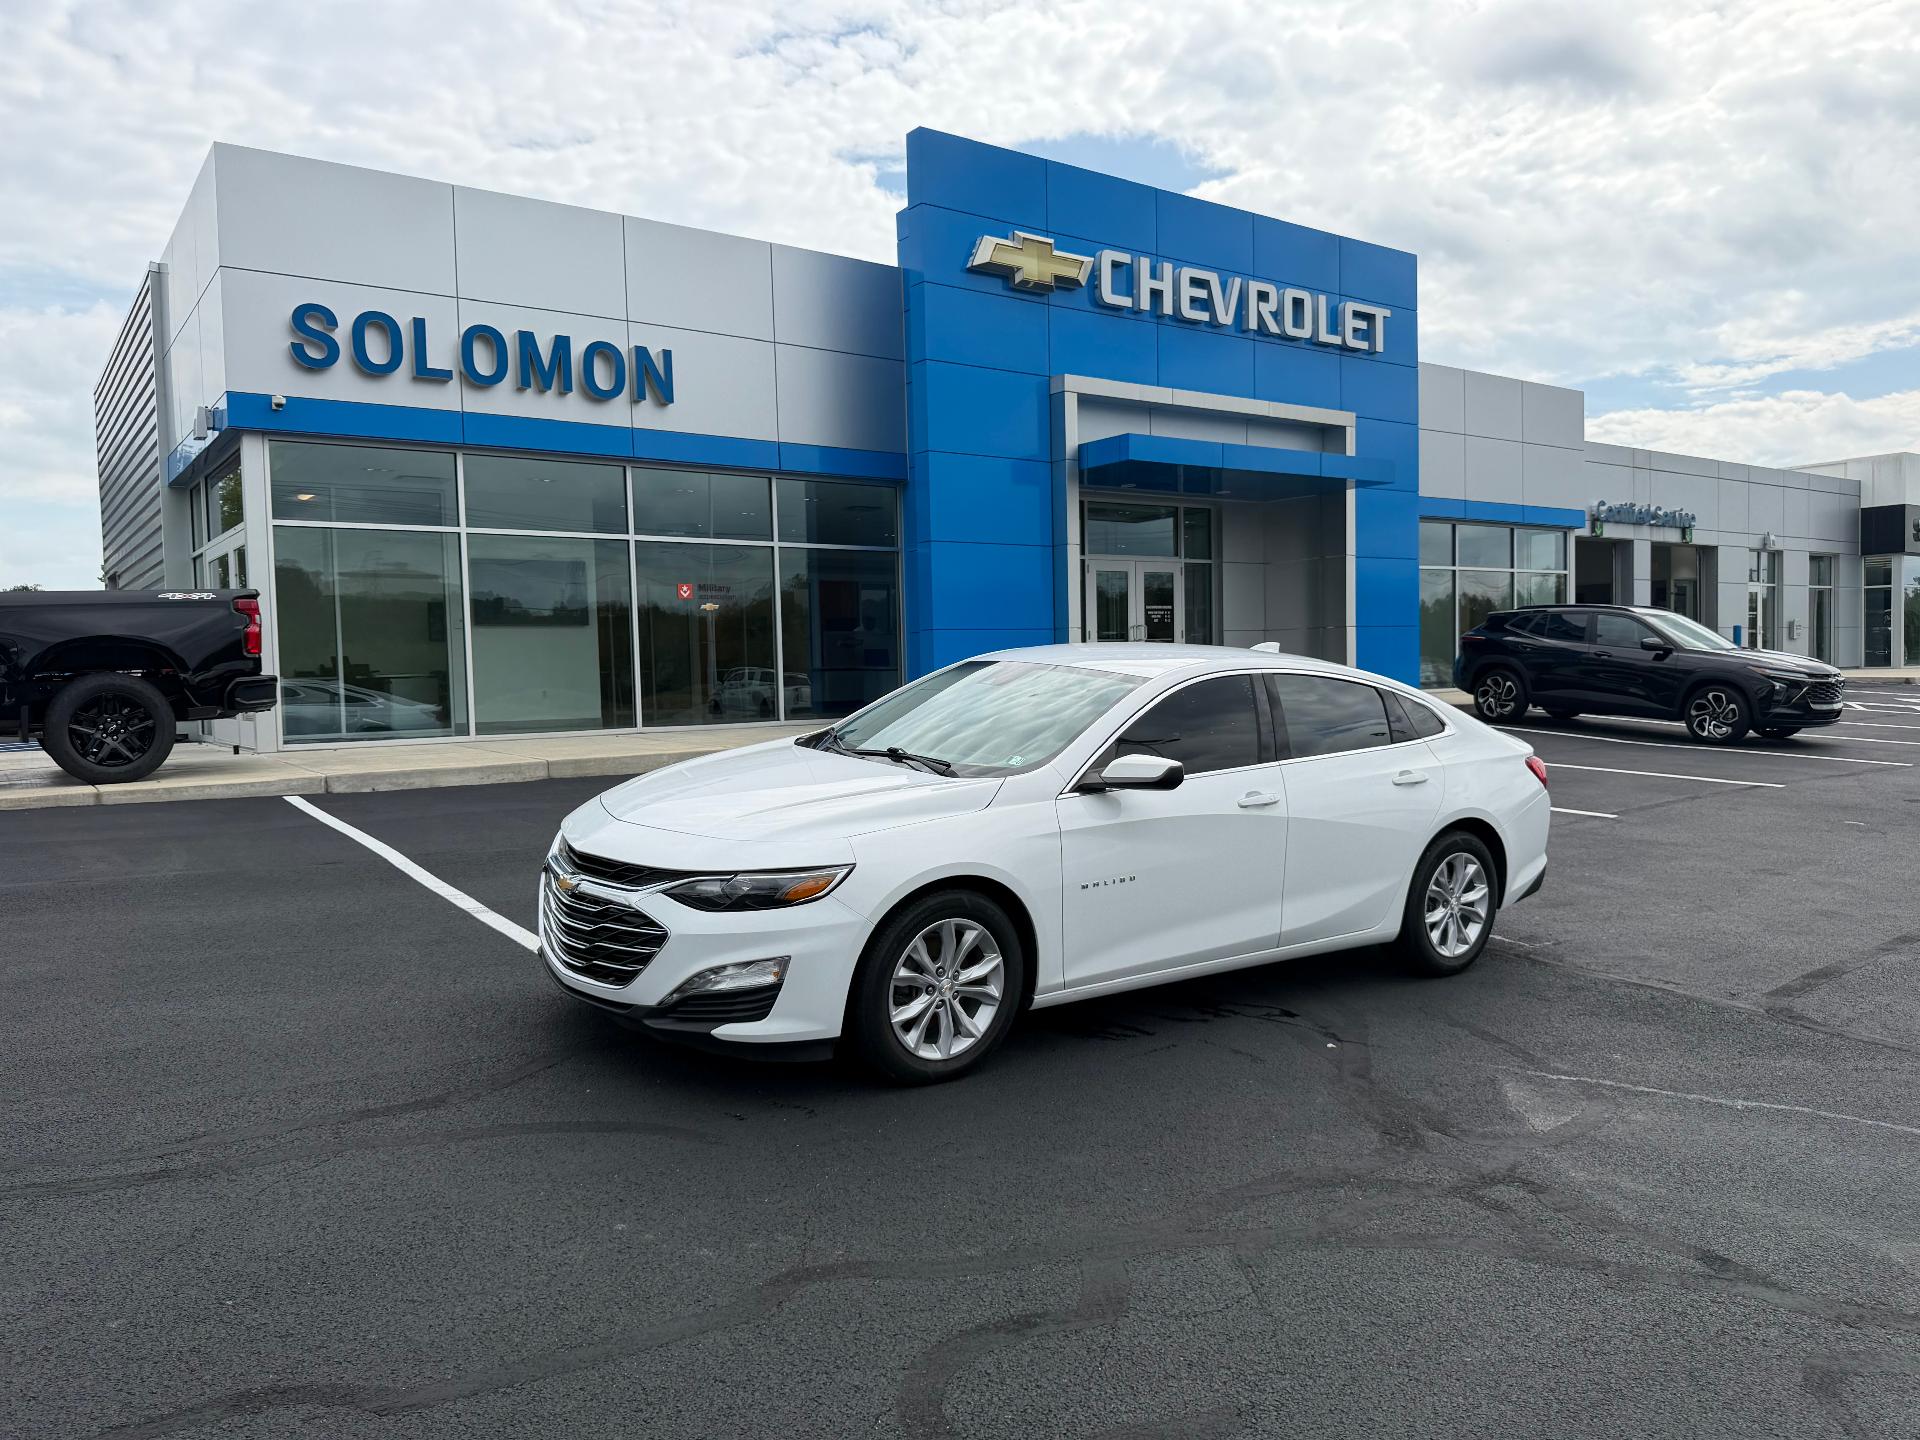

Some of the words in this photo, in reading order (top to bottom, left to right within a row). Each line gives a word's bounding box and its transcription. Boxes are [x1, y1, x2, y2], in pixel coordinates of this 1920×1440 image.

[1095, 249, 1391, 352] CHEVROLET
[289, 303, 674, 404] SOLOMON
[1598, 500, 1651, 525] Certified
[1651, 506, 1696, 529] Service
[1081, 875, 1136, 890] MALIBU
